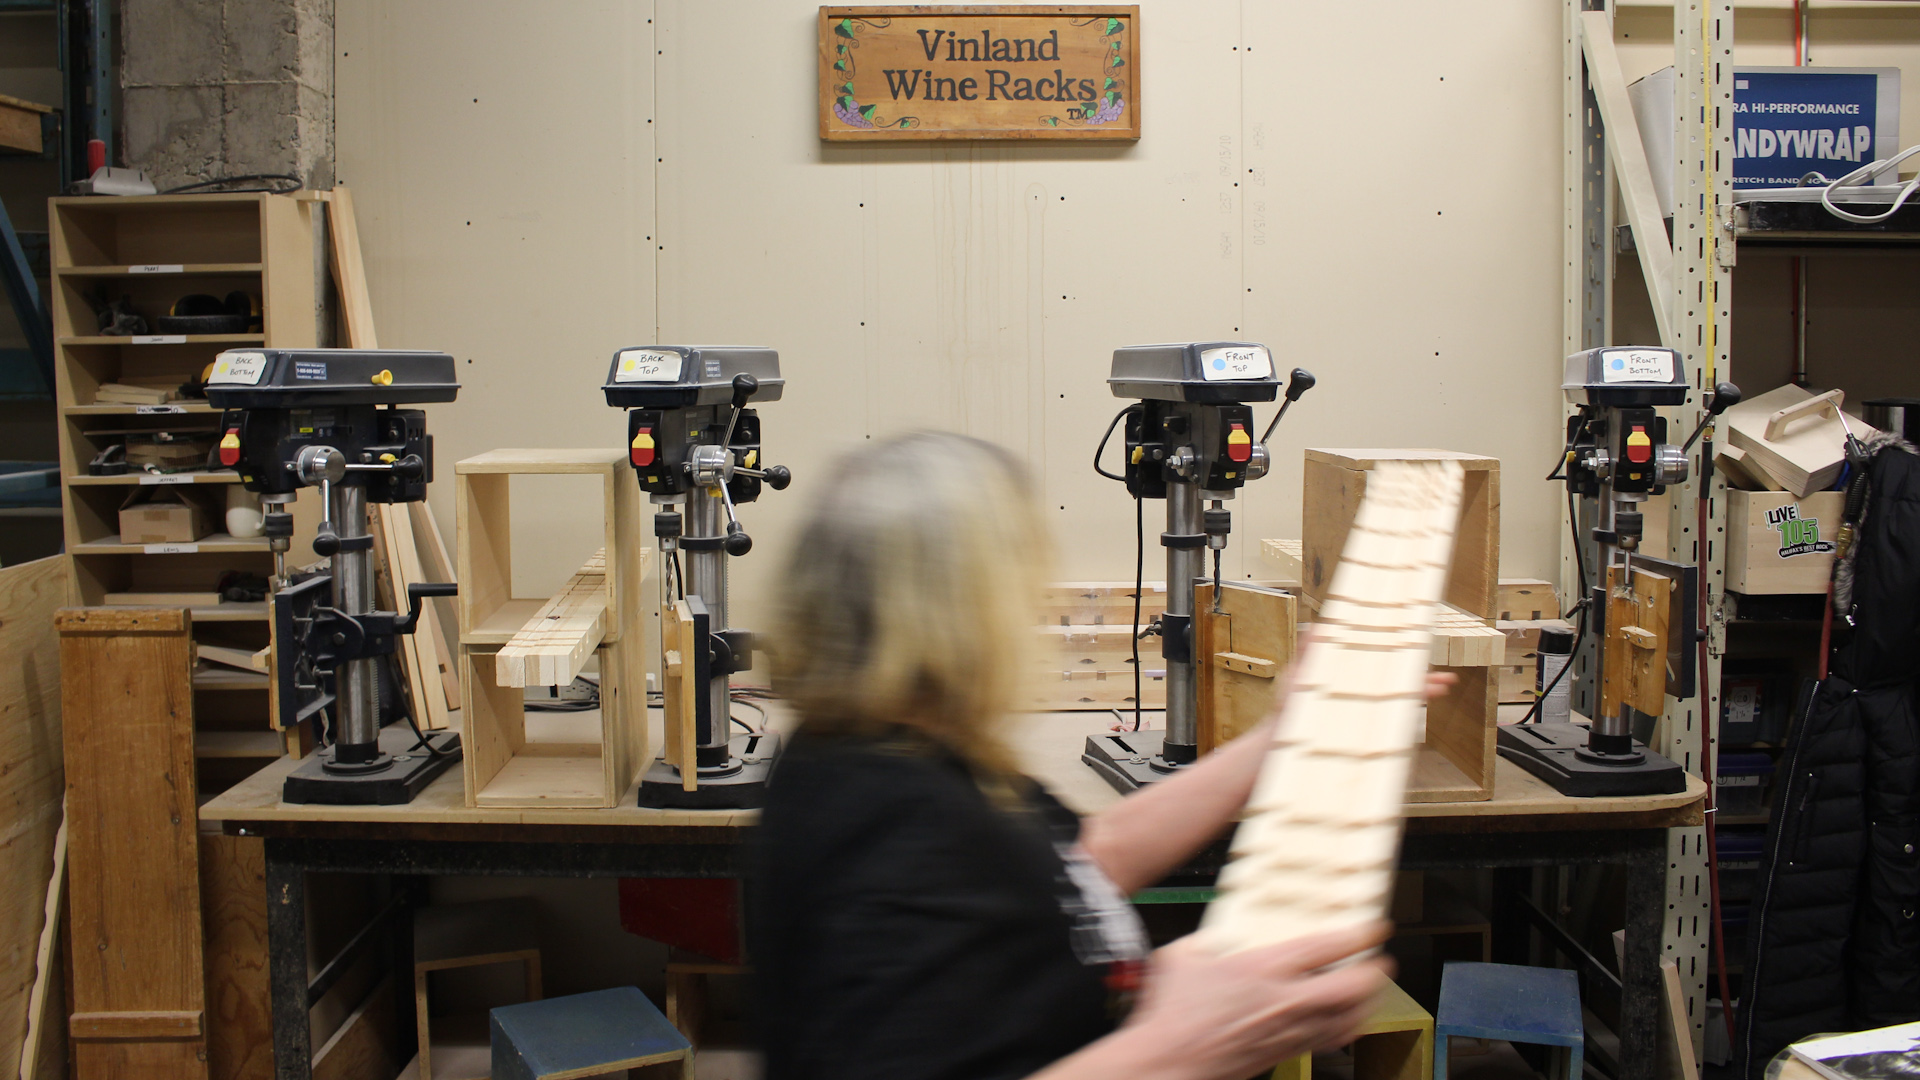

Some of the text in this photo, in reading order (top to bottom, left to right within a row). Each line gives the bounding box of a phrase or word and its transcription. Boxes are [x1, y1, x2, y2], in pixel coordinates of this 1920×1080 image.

[916, 29, 1060, 62] Vinland
[883, 69, 1098, 103] Wine Racks
[1752, 103, 1860, 115] HI-PERFORMANCE
[235, 356, 253, 365] BACK
[639, 354, 665, 363] BACK
[1629, 367, 1662, 376] BOTTOM
[1768, 506, 1797, 524] LIVE
[1778, 519, 1818, 549] 105
